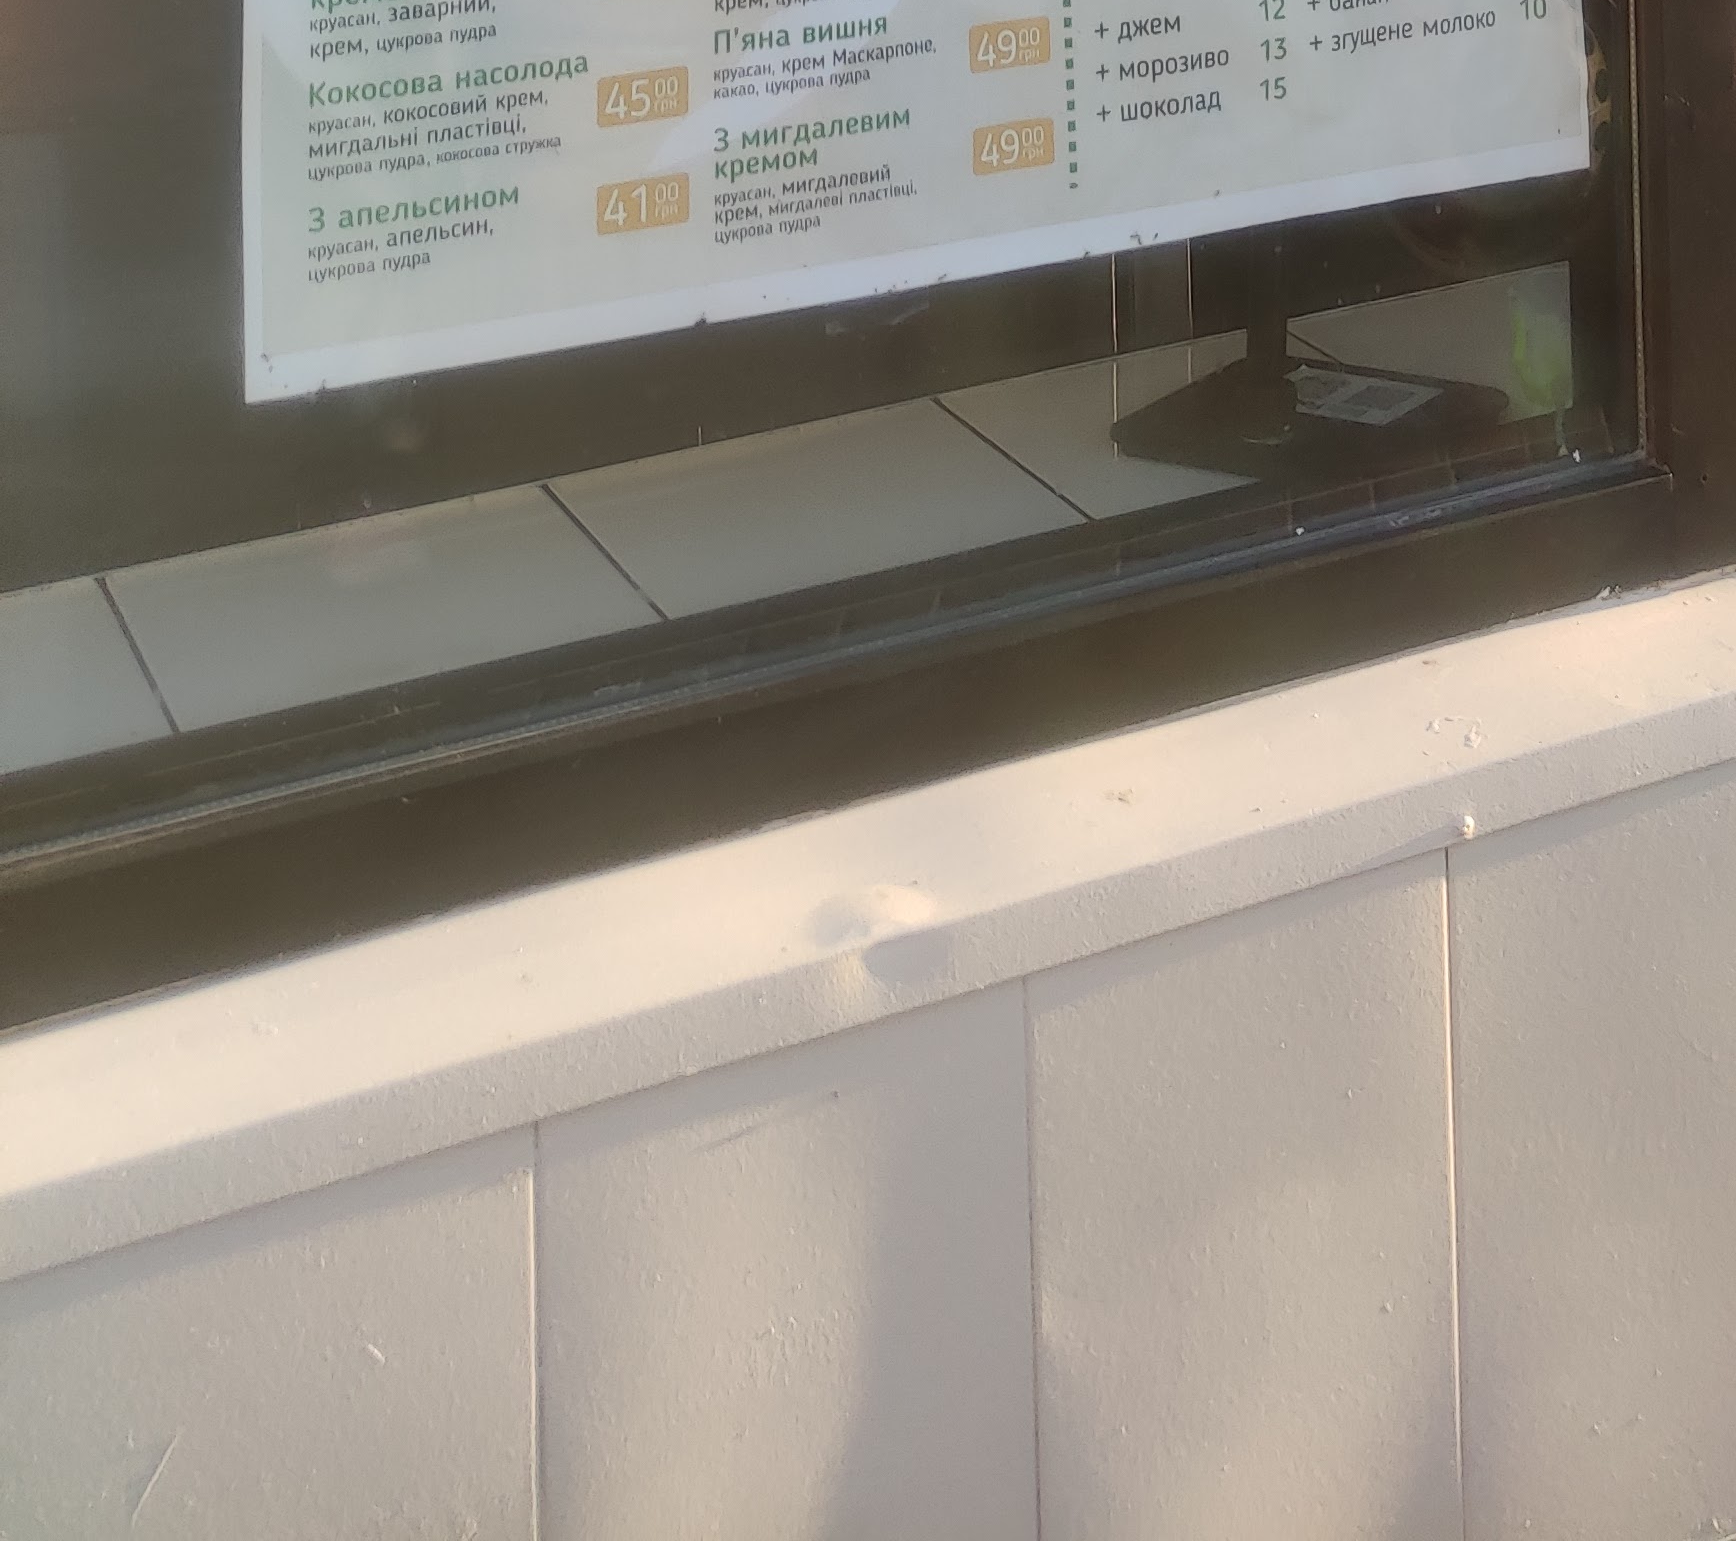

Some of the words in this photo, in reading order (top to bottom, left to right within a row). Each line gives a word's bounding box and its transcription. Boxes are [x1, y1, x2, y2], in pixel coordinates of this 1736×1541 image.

[802, 16, 887, 45] вишня
[309, 74, 443, 109] Кокосова
[455, 55, 589, 90] насолода
[308, 206, 326, 234] З
[338, 186, 519, 229] апельсином
